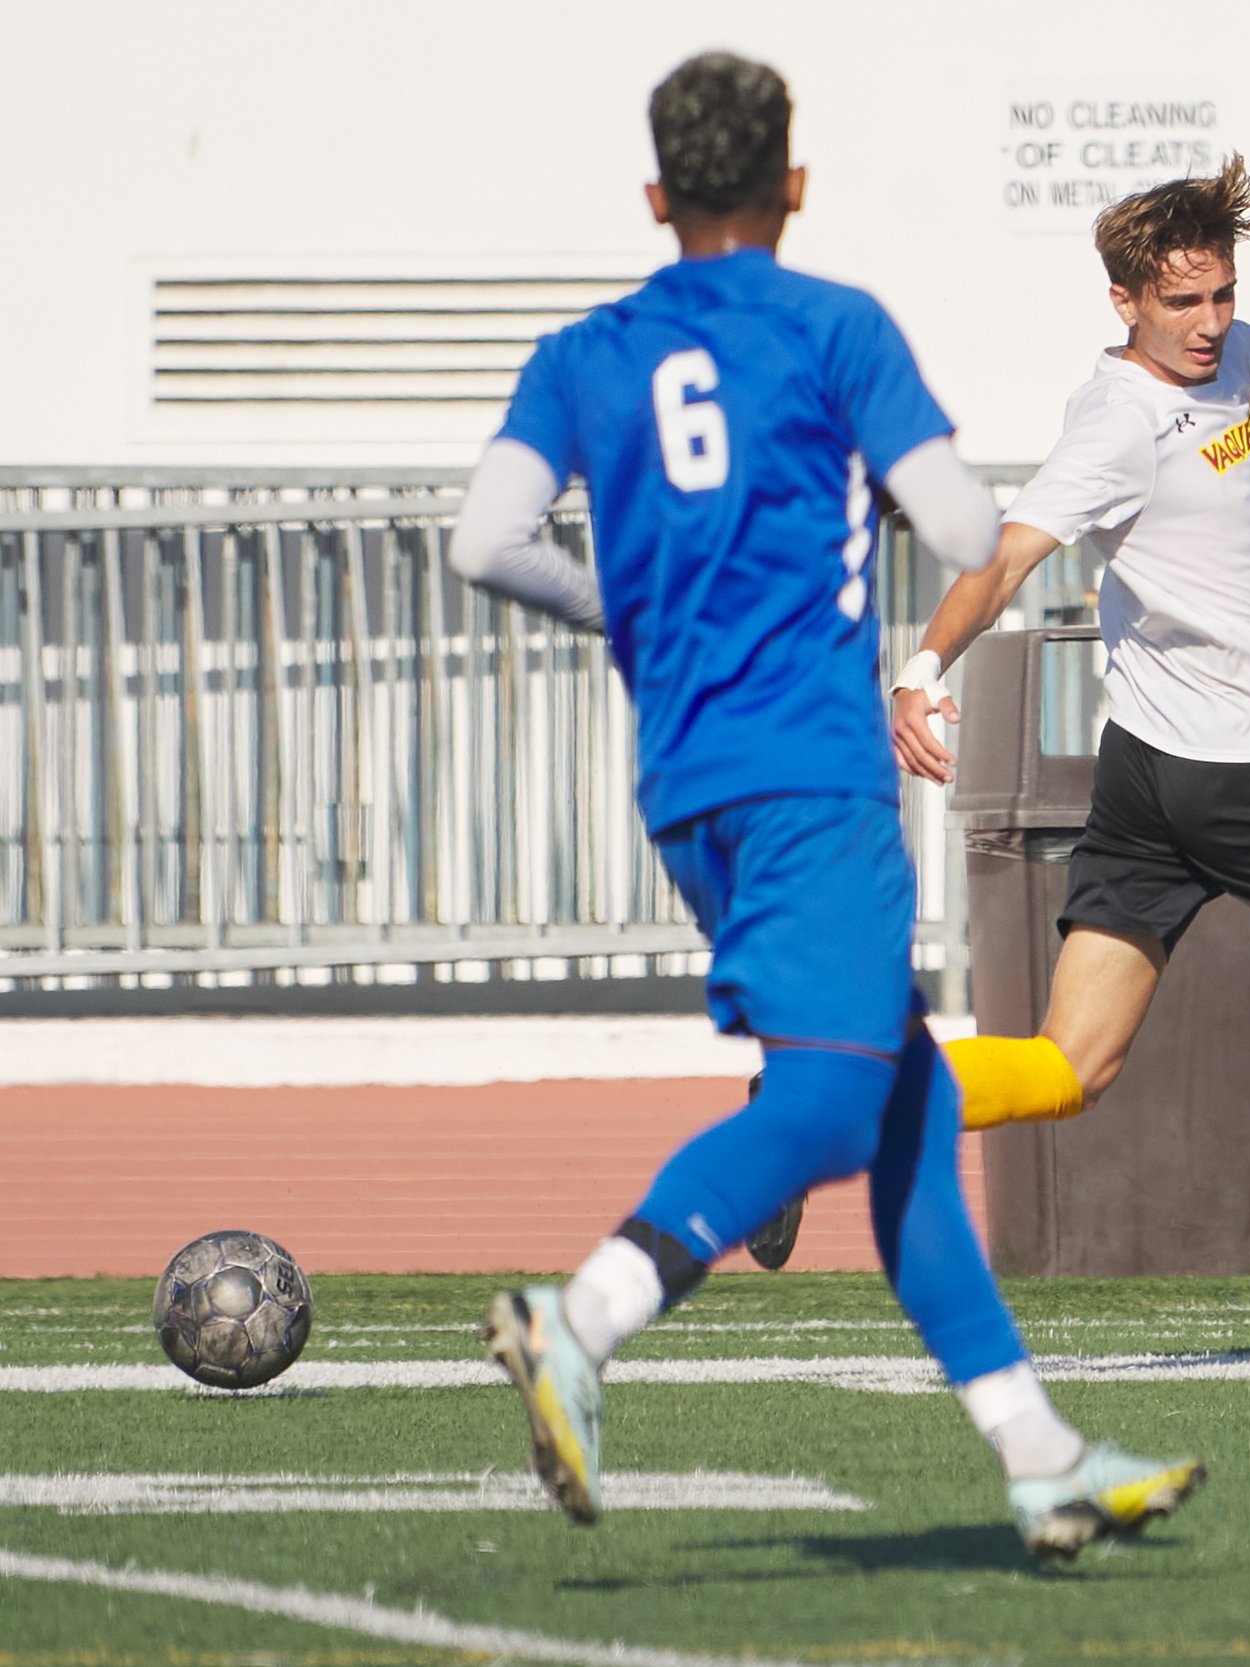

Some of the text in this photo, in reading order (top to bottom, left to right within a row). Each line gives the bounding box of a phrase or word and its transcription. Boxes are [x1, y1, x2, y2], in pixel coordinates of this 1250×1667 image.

[1010, 101, 1216, 129] NO CLEANING
[1015, 141, 1211, 169] OF CLEATS
[1004, 180, 1039, 208] ON
[652, 348, 730, 493] 6
